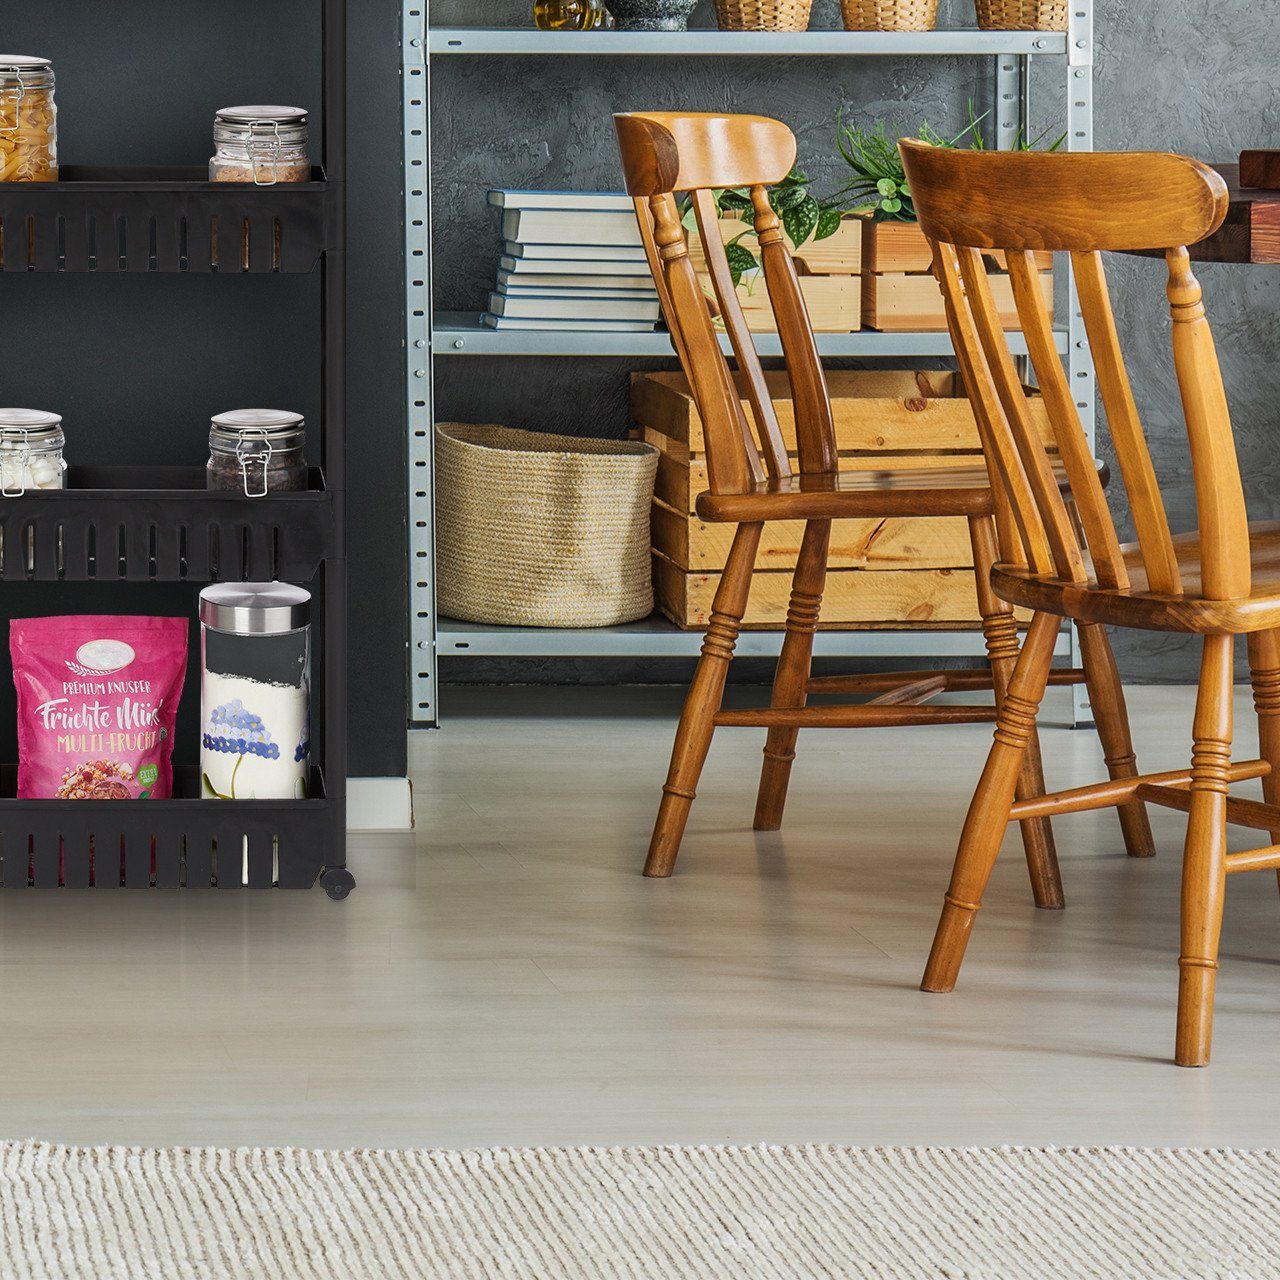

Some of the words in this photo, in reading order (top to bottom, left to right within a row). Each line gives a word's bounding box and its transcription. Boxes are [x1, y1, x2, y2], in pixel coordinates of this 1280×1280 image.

[62, 680, 106, 695] PREMIUM
[107, 679, 152, 695] KNUSPER
[34, 697, 113, 732] Früchte
